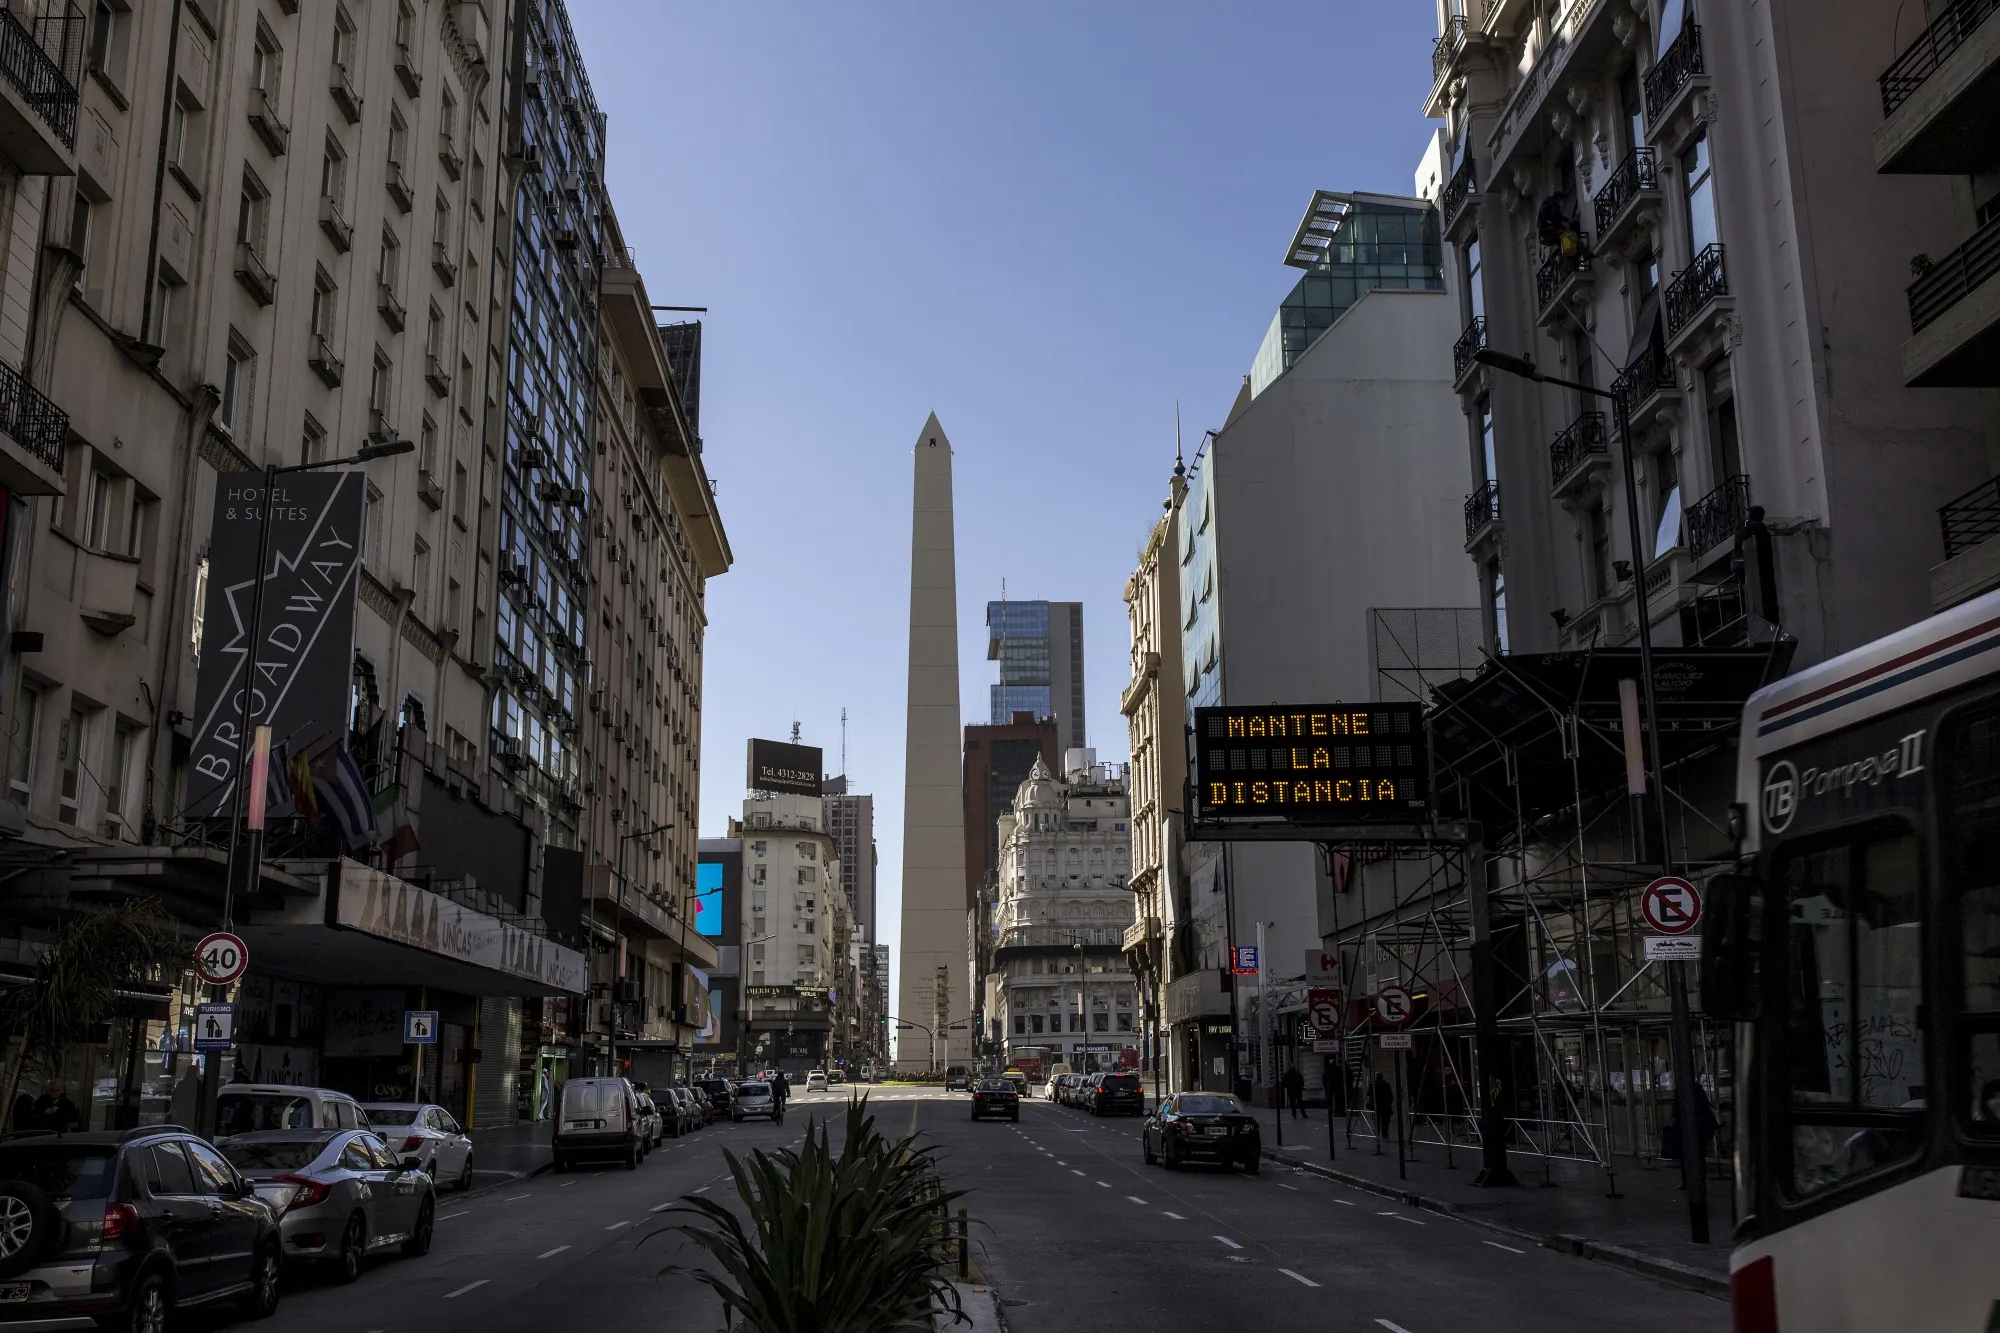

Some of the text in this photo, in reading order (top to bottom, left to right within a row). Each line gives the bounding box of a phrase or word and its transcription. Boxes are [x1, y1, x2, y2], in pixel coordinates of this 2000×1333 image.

[228, 488, 291, 502] HOTEL
[226, 507, 307, 521] & SUITES
[195, 526, 353, 782] BROADWAY
[1228, 712, 1370, 738] MANTENE
[1291, 747, 1331, 770] LA
[1801, 747, 1899, 800] Pompeya
[1896, 728, 1927, 779] II
[761, 765, 815, 782] Tel. 4312-2828
[1210, 778, 1396, 804] DISTANCIA
[441, 921, 472, 957] UNICAS
[205, 948, 237, 969] 40
